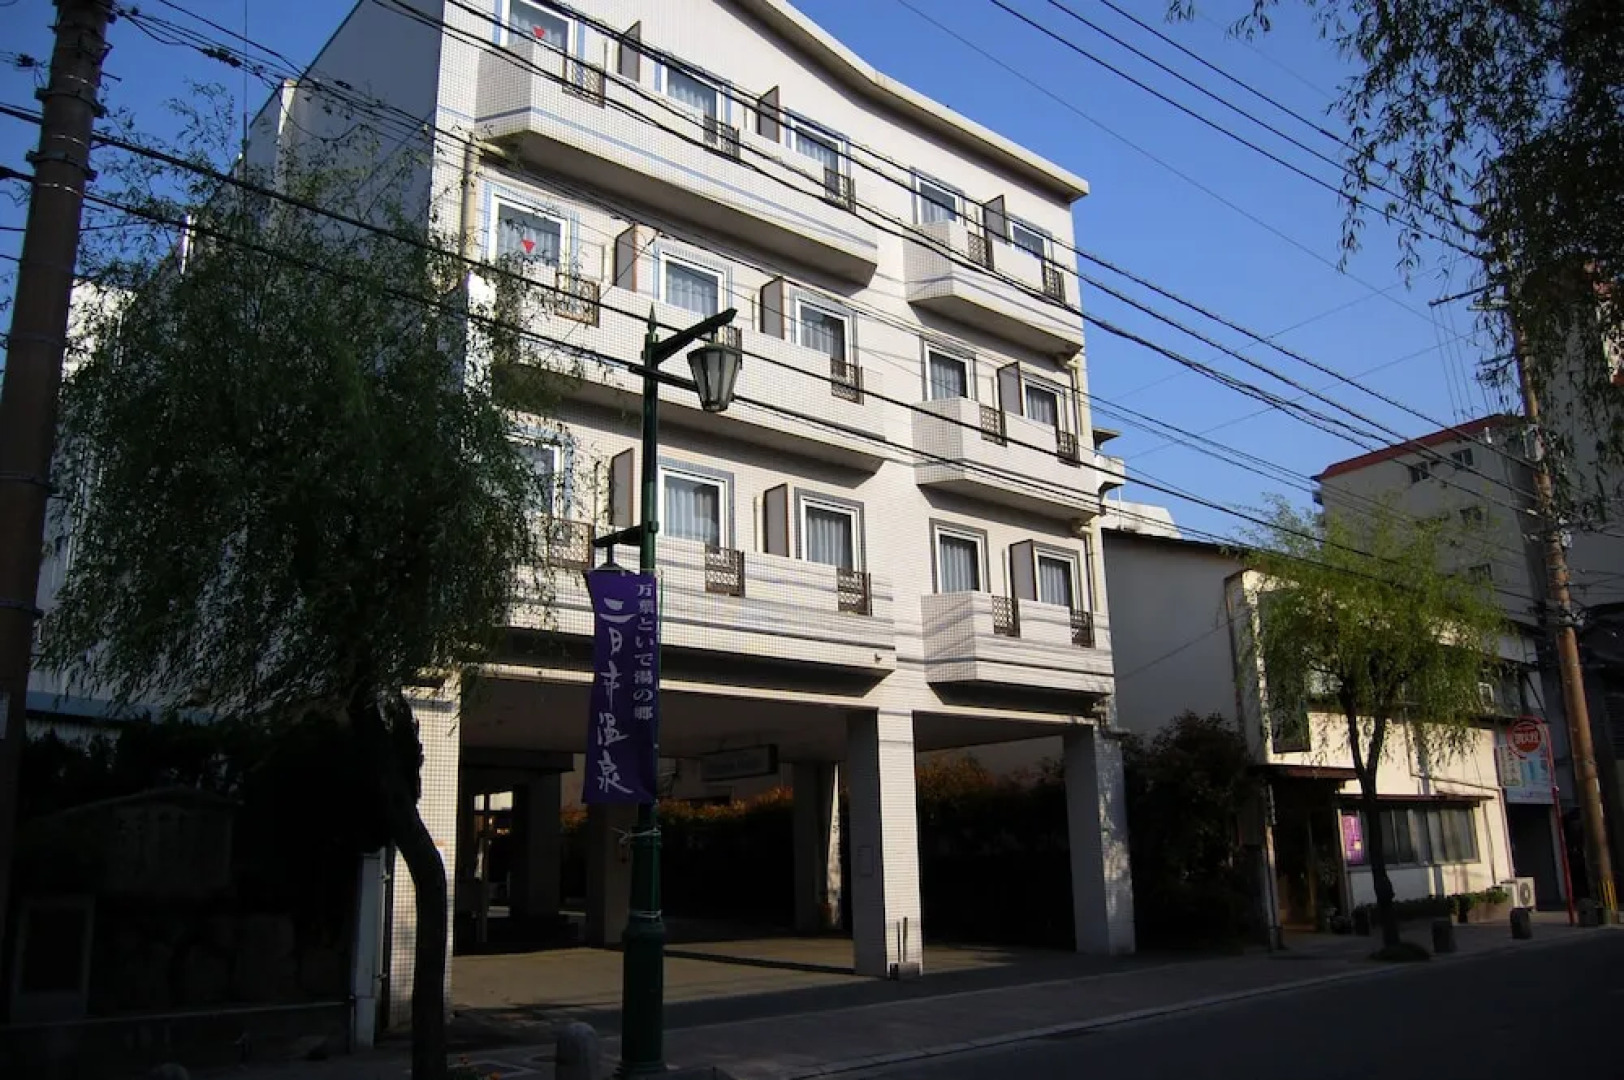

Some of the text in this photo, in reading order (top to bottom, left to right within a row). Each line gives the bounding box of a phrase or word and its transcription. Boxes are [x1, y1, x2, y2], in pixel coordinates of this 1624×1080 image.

[596, 598, 635, 793] 二日市温泉
